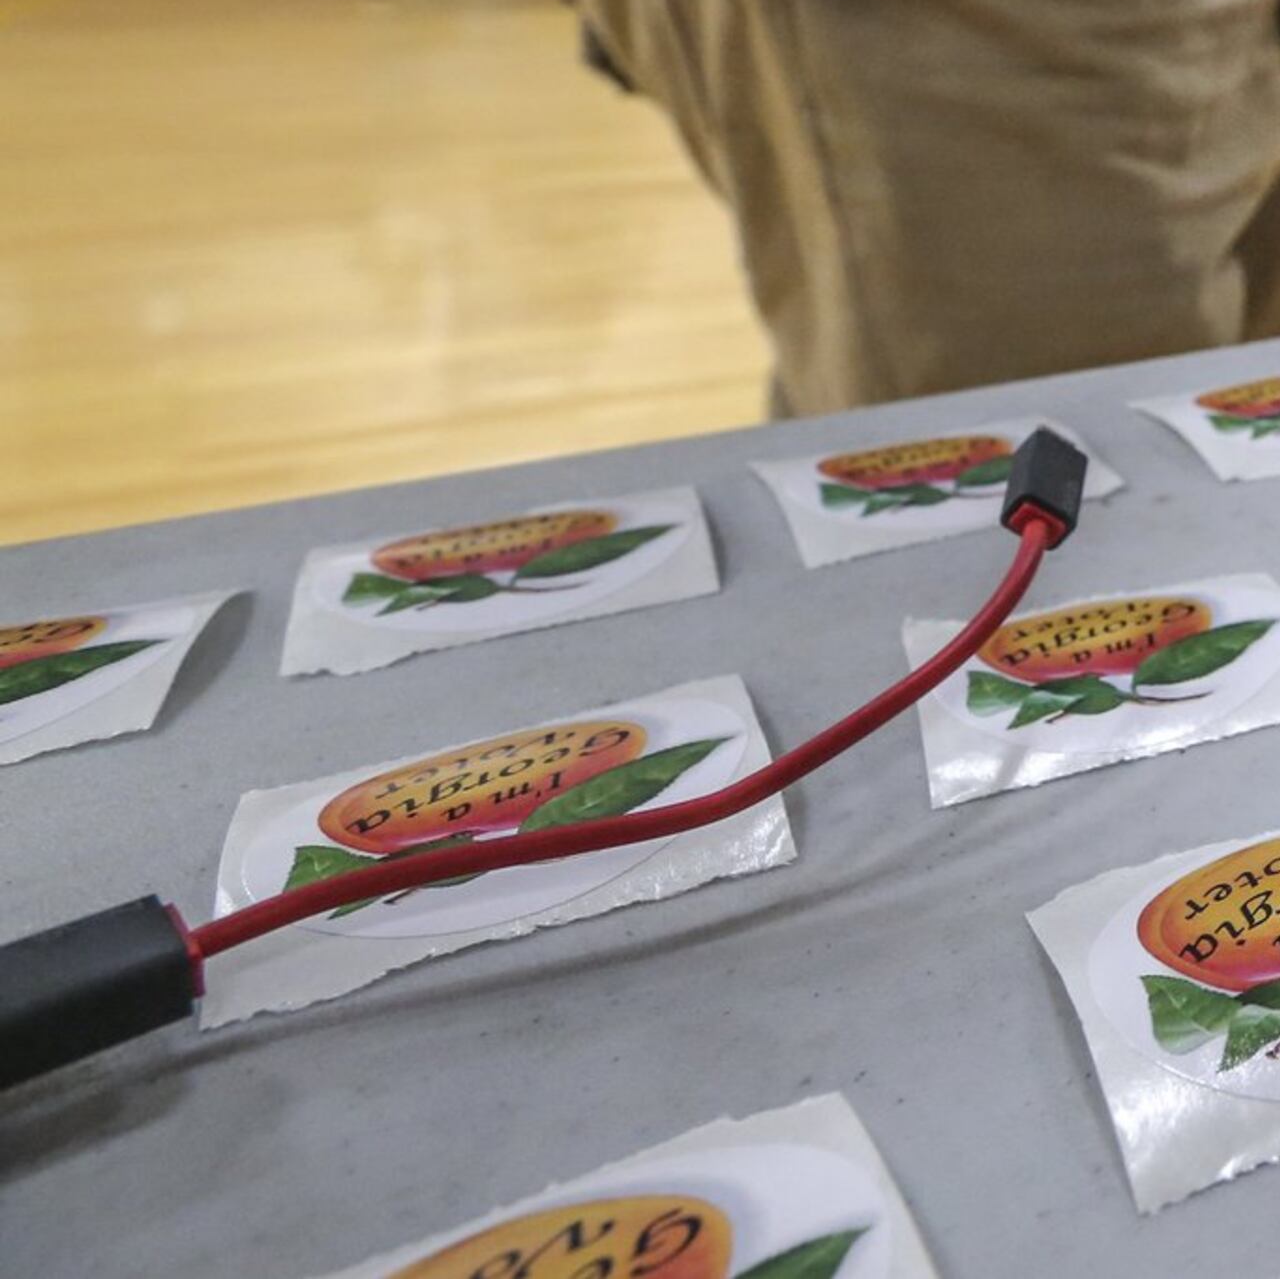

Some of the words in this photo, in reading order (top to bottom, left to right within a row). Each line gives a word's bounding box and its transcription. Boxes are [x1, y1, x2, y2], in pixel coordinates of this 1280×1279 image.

[1003, 602, 1196, 665] Georgia
[1012, 602, 1151, 641] Voter
[1073, 650, 1092, 664] a
[345, 727, 630, 834] Georgia
[375, 731, 576, 800] Voter
[494, 771, 566, 803] I'm
[440, 802, 472, 822] a
